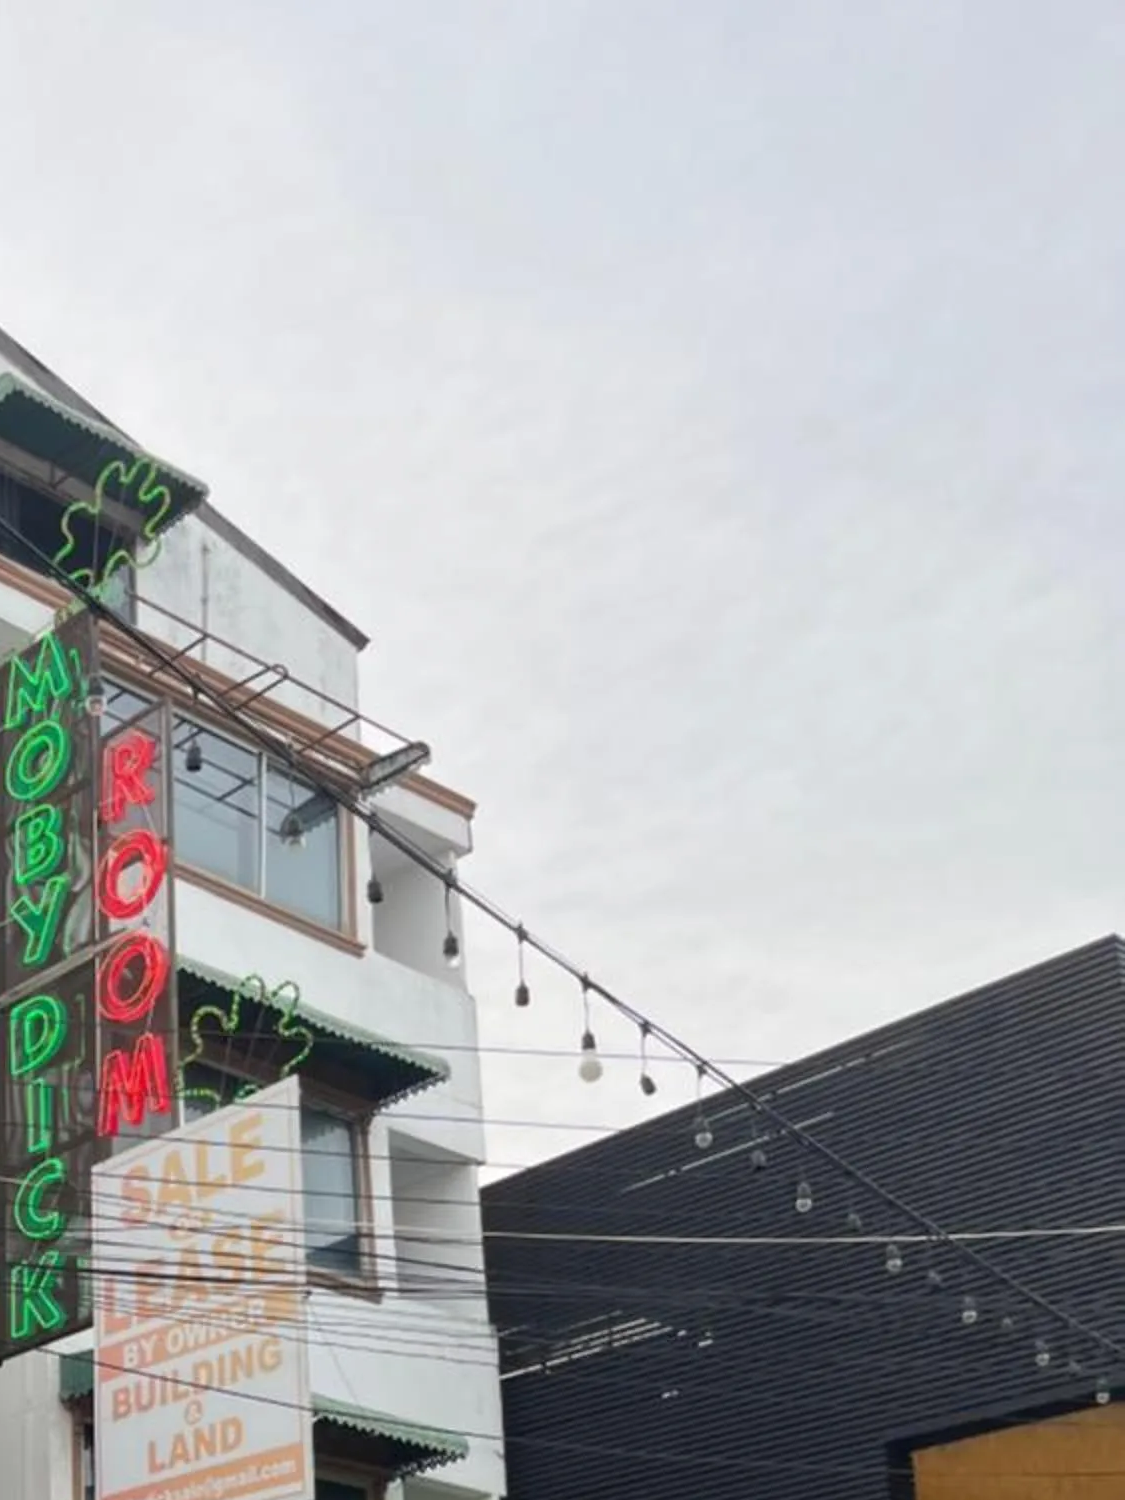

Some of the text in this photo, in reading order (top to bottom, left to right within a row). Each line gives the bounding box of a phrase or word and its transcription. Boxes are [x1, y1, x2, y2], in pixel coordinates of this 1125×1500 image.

[5, 632, 70, 965] MOBY
[97, 728, 170, 1137] ROOM
[9, 995, 67, 1339] DICK
[119, 1112, 266, 1230] SALE
[101, 1213, 287, 1336] LEASE
[110, 1337, 285, 1423] BUILDING
[123, 1301, 267, 1370] BY OWNER
[147, 1415, 245, 1475] LAND
[184, 1400, 204, 1425] &
